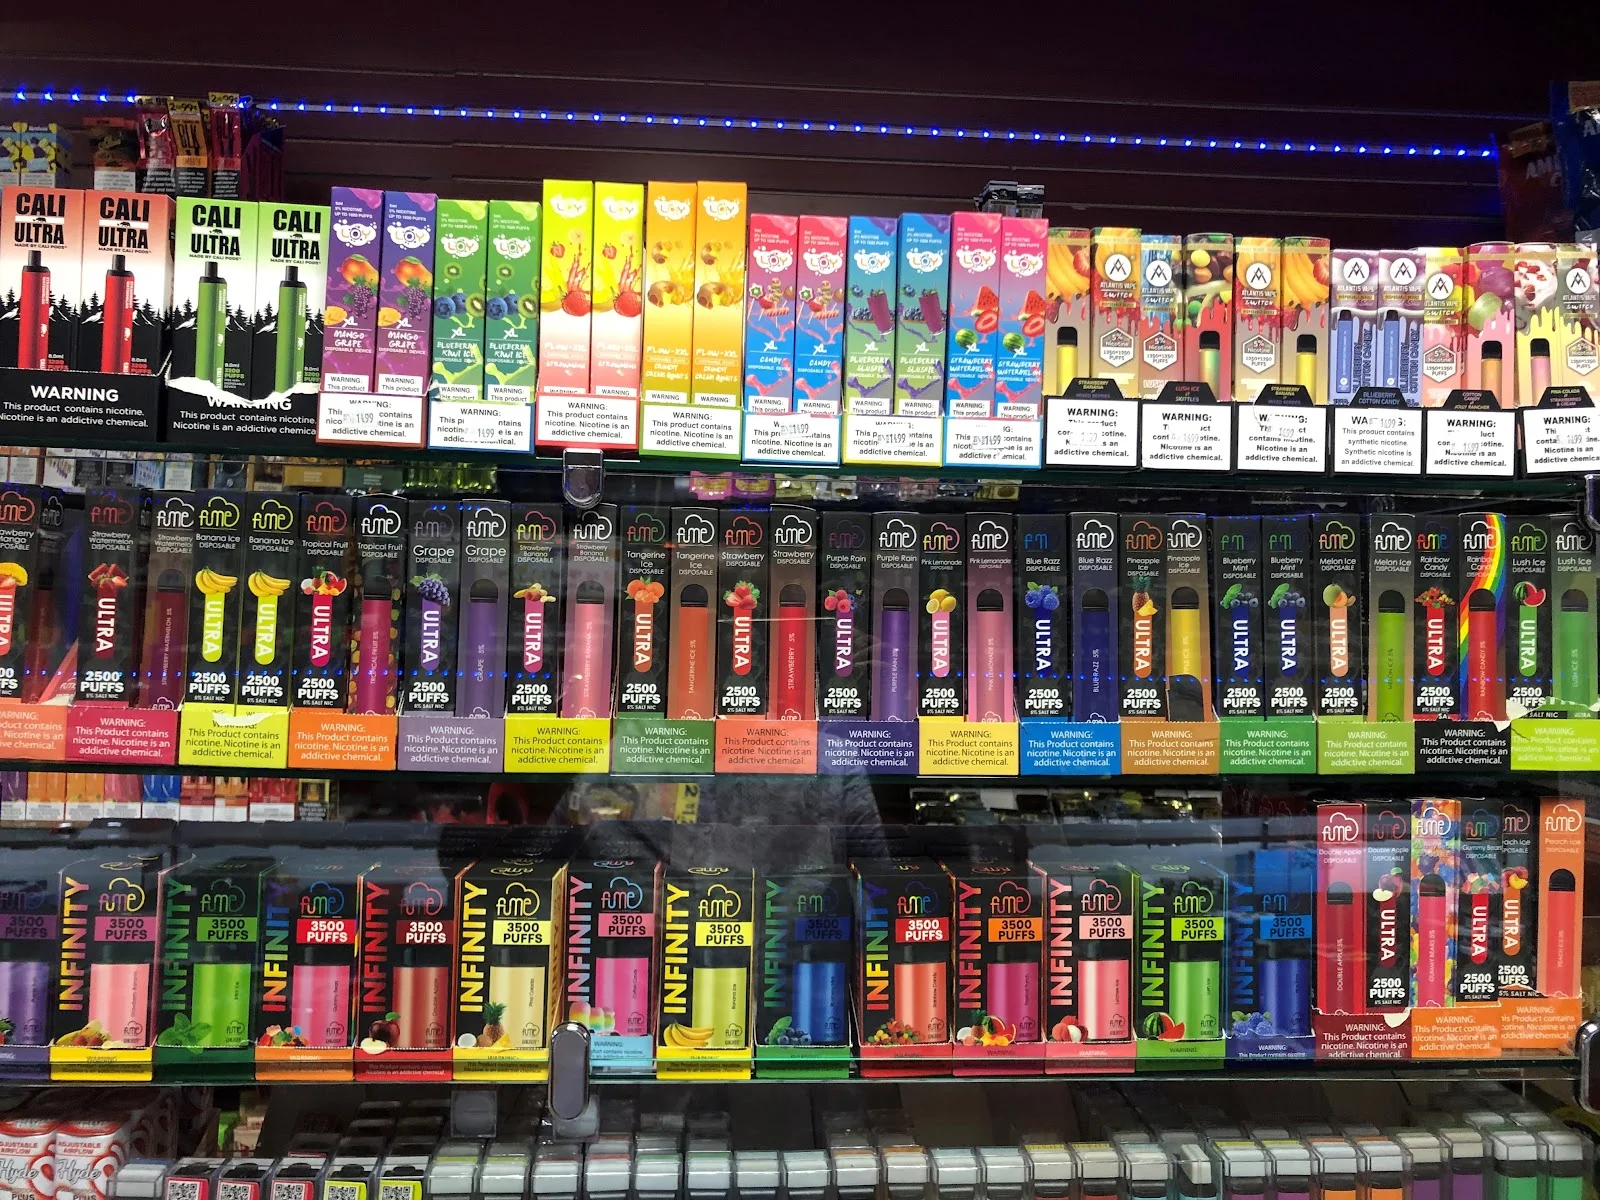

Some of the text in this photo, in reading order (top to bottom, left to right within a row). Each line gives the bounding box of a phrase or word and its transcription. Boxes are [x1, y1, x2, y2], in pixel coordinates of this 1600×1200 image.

[16, 193, 65, 215] CALI
[100, 197, 149, 221] CALI
[192, 204, 241, 228] CALI
[273, 209, 321, 233] CALI
[14, 223, 64, 245] ULTRA
[98, 227, 148, 250] ULTRA
[191, 234, 240, 256] ULTRA
[272, 239, 320, 261] ULTRA
[334, 330, 364, 340] MANGO
[335, 340, 362, 348] GRAPE
[760, 356, 781, 365] CANDY
[30, 385, 119, 402] WARNING
[4, 402, 144, 416] This product contains nicotine.
[568, 402, 607, 410] WARNING:
[565, 412, 594, 421] product
[673, 412, 712, 420] WARNING:
[1067, 408, 1118, 417] WARNING:
[1162, 413, 1212, 422] WARNING:
[36, 414, 44, 423] is
[61, 415, 103, 426] addictive
[106, 416, 148, 427] chemical.
[1447, 419, 1496, 428] WARNING:
[587, 430, 623, 439] chemical.
[691, 440, 727, 449] chemical.
[1149, 453, 1223, 462] addictive chemical.
[91, 531, 131, 540] Strawberry
[196, 533, 226, 542] Banana
[302, 540, 331, 549] Tropical
[413, 545, 454, 559] Grape
[465, 545, 506, 559] Grape
[627, 551, 665, 560] Tangerine
[722, 552, 764, 562] Strawberry
[826, 554, 866, 564] Purple Rain
[203, 601, 222, 655] ULTRA
[422, 610, 440, 664] ULTRA
[734, 616, 750, 668] ULTRA
[1136, 619, 1150, 670] ULTRA
[1233, 620, 1249, 671] ULTRA
[86, 671, 120, 681] 2500
[194, 672, 226, 684] 2500
[80, 681, 124, 693] PUFFS
[189, 682, 231, 695] PUFFS
[302, 678, 335, 689] 2500
[413, 682, 446, 693] 2500
[298, 689, 339, 700] PUFFS
[726, 686, 756, 697] 2500
[1028, 688, 1059, 699] 2500
[1227, 688, 1256, 697] 2500
[409, 692, 449, 704] PUFFS
[722, 696, 761, 707] PUFFS
[1224, 698, 1261, 708] PUFFS
[1025, 698, 1063, 709] PUFFS
[321, 723, 365, 732] WARNING:
[849, 730, 891, 739] WARNING:
[1440, 738, 1471, 747] Product
[1034, 758, 1110, 766] addictive chemical.
[110, 919, 144, 929] 3500
[211, 919, 245, 929] 3500
[310, 921, 344, 932] 3500
[507, 922, 539, 933] 3500
[908, 920, 939, 930] 3500
[1092, 918, 1122, 928] 3500
[1184, 919, 1214, 929] 3500
[709, 924, 741, 934] 3500
[1089, 928, 1125, 938] PUFFS
[105, 930, 147, 940] PUFFS
[207, 930, 248, 940] PUFFS
[306, 932, 348, 943] PUFFS
[503, 934, 543, 944] PUFFS
[905, 931, 943, 941] PUFFS
[1181, 930, 1217, 939] PUFFS
[59, 877, 89, 1011] INFINITY
[706, 935, 744, 945] PUFFS
[1050, 878, 1072, 1006] INFINITY
[1142, 881, 1164, 1006] INFINITY
[460, 881, 487, 1013] INFINITY
[664, 883, 690, 1014] INFINITY
[1373, 978, 1401, 988] 2500
[1370, 988, 1405, 999] PUFFS
